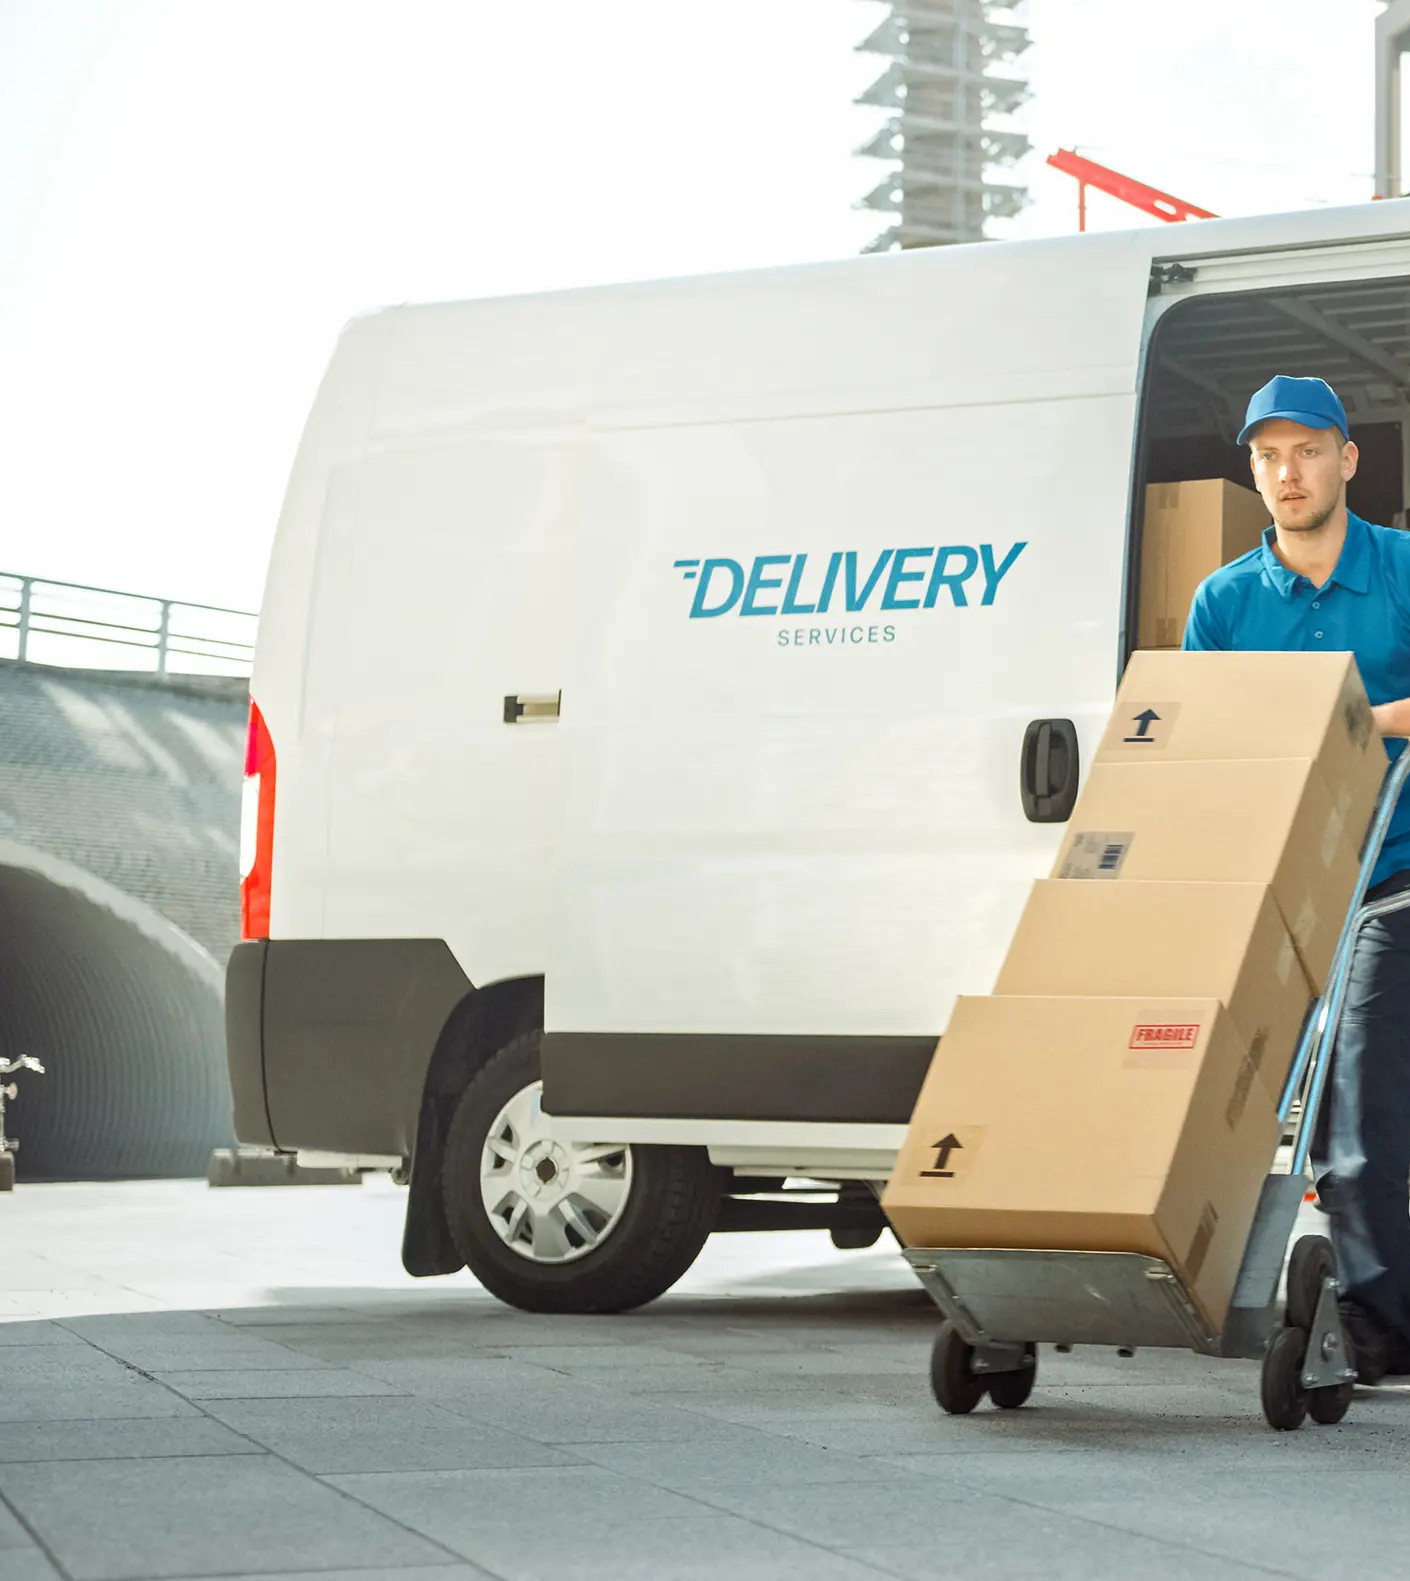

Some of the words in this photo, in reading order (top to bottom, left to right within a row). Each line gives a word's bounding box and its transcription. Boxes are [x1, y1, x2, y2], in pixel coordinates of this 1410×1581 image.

[689, 541, 1028, 619] DELIVERY
[777, 625, 896, 646] SERVICES
[1136, 1028, 1194, 1041] FRAGILE
